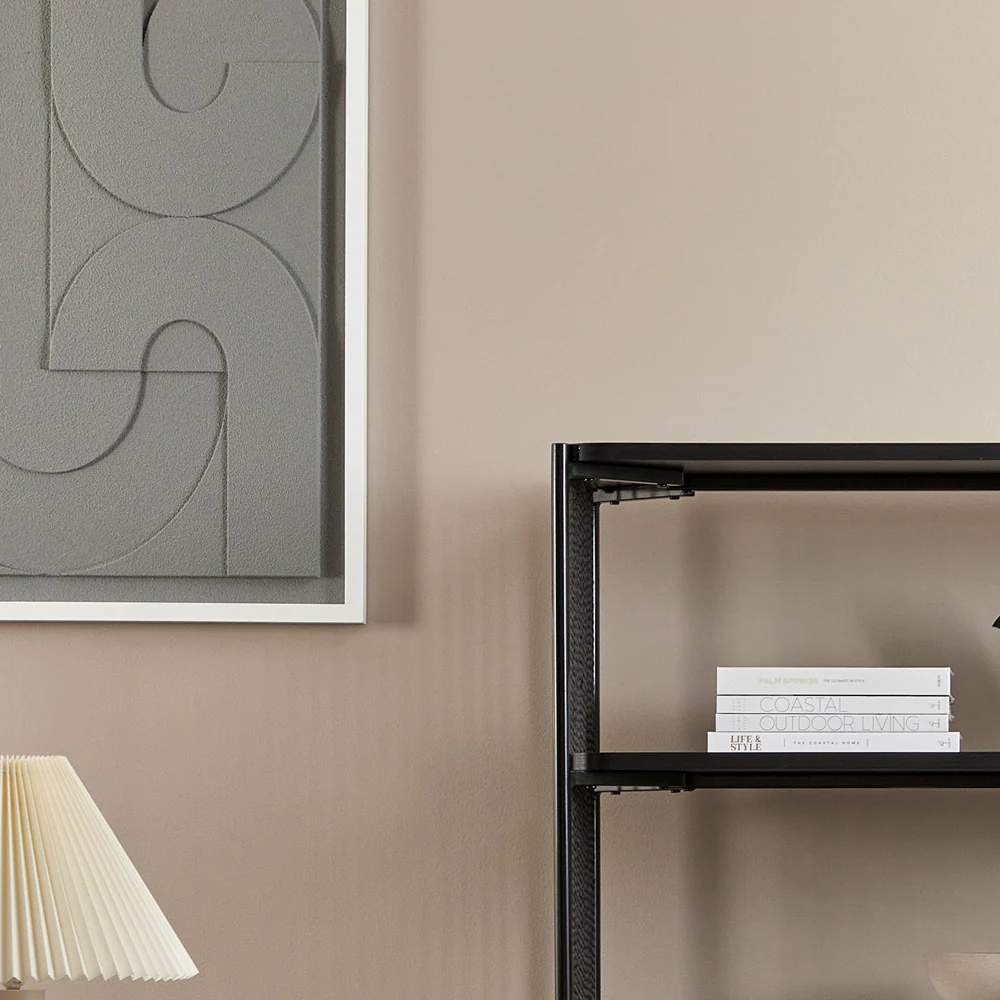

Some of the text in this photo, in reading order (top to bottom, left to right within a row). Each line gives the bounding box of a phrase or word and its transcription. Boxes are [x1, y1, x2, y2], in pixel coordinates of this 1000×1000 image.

[760, 697, 847, 712] COASTAL
[760, 716, 854, 730] OUTDOOR
[862, 716, 920, 730] LIVING
[730, 735, 762, 743] LIFE &
